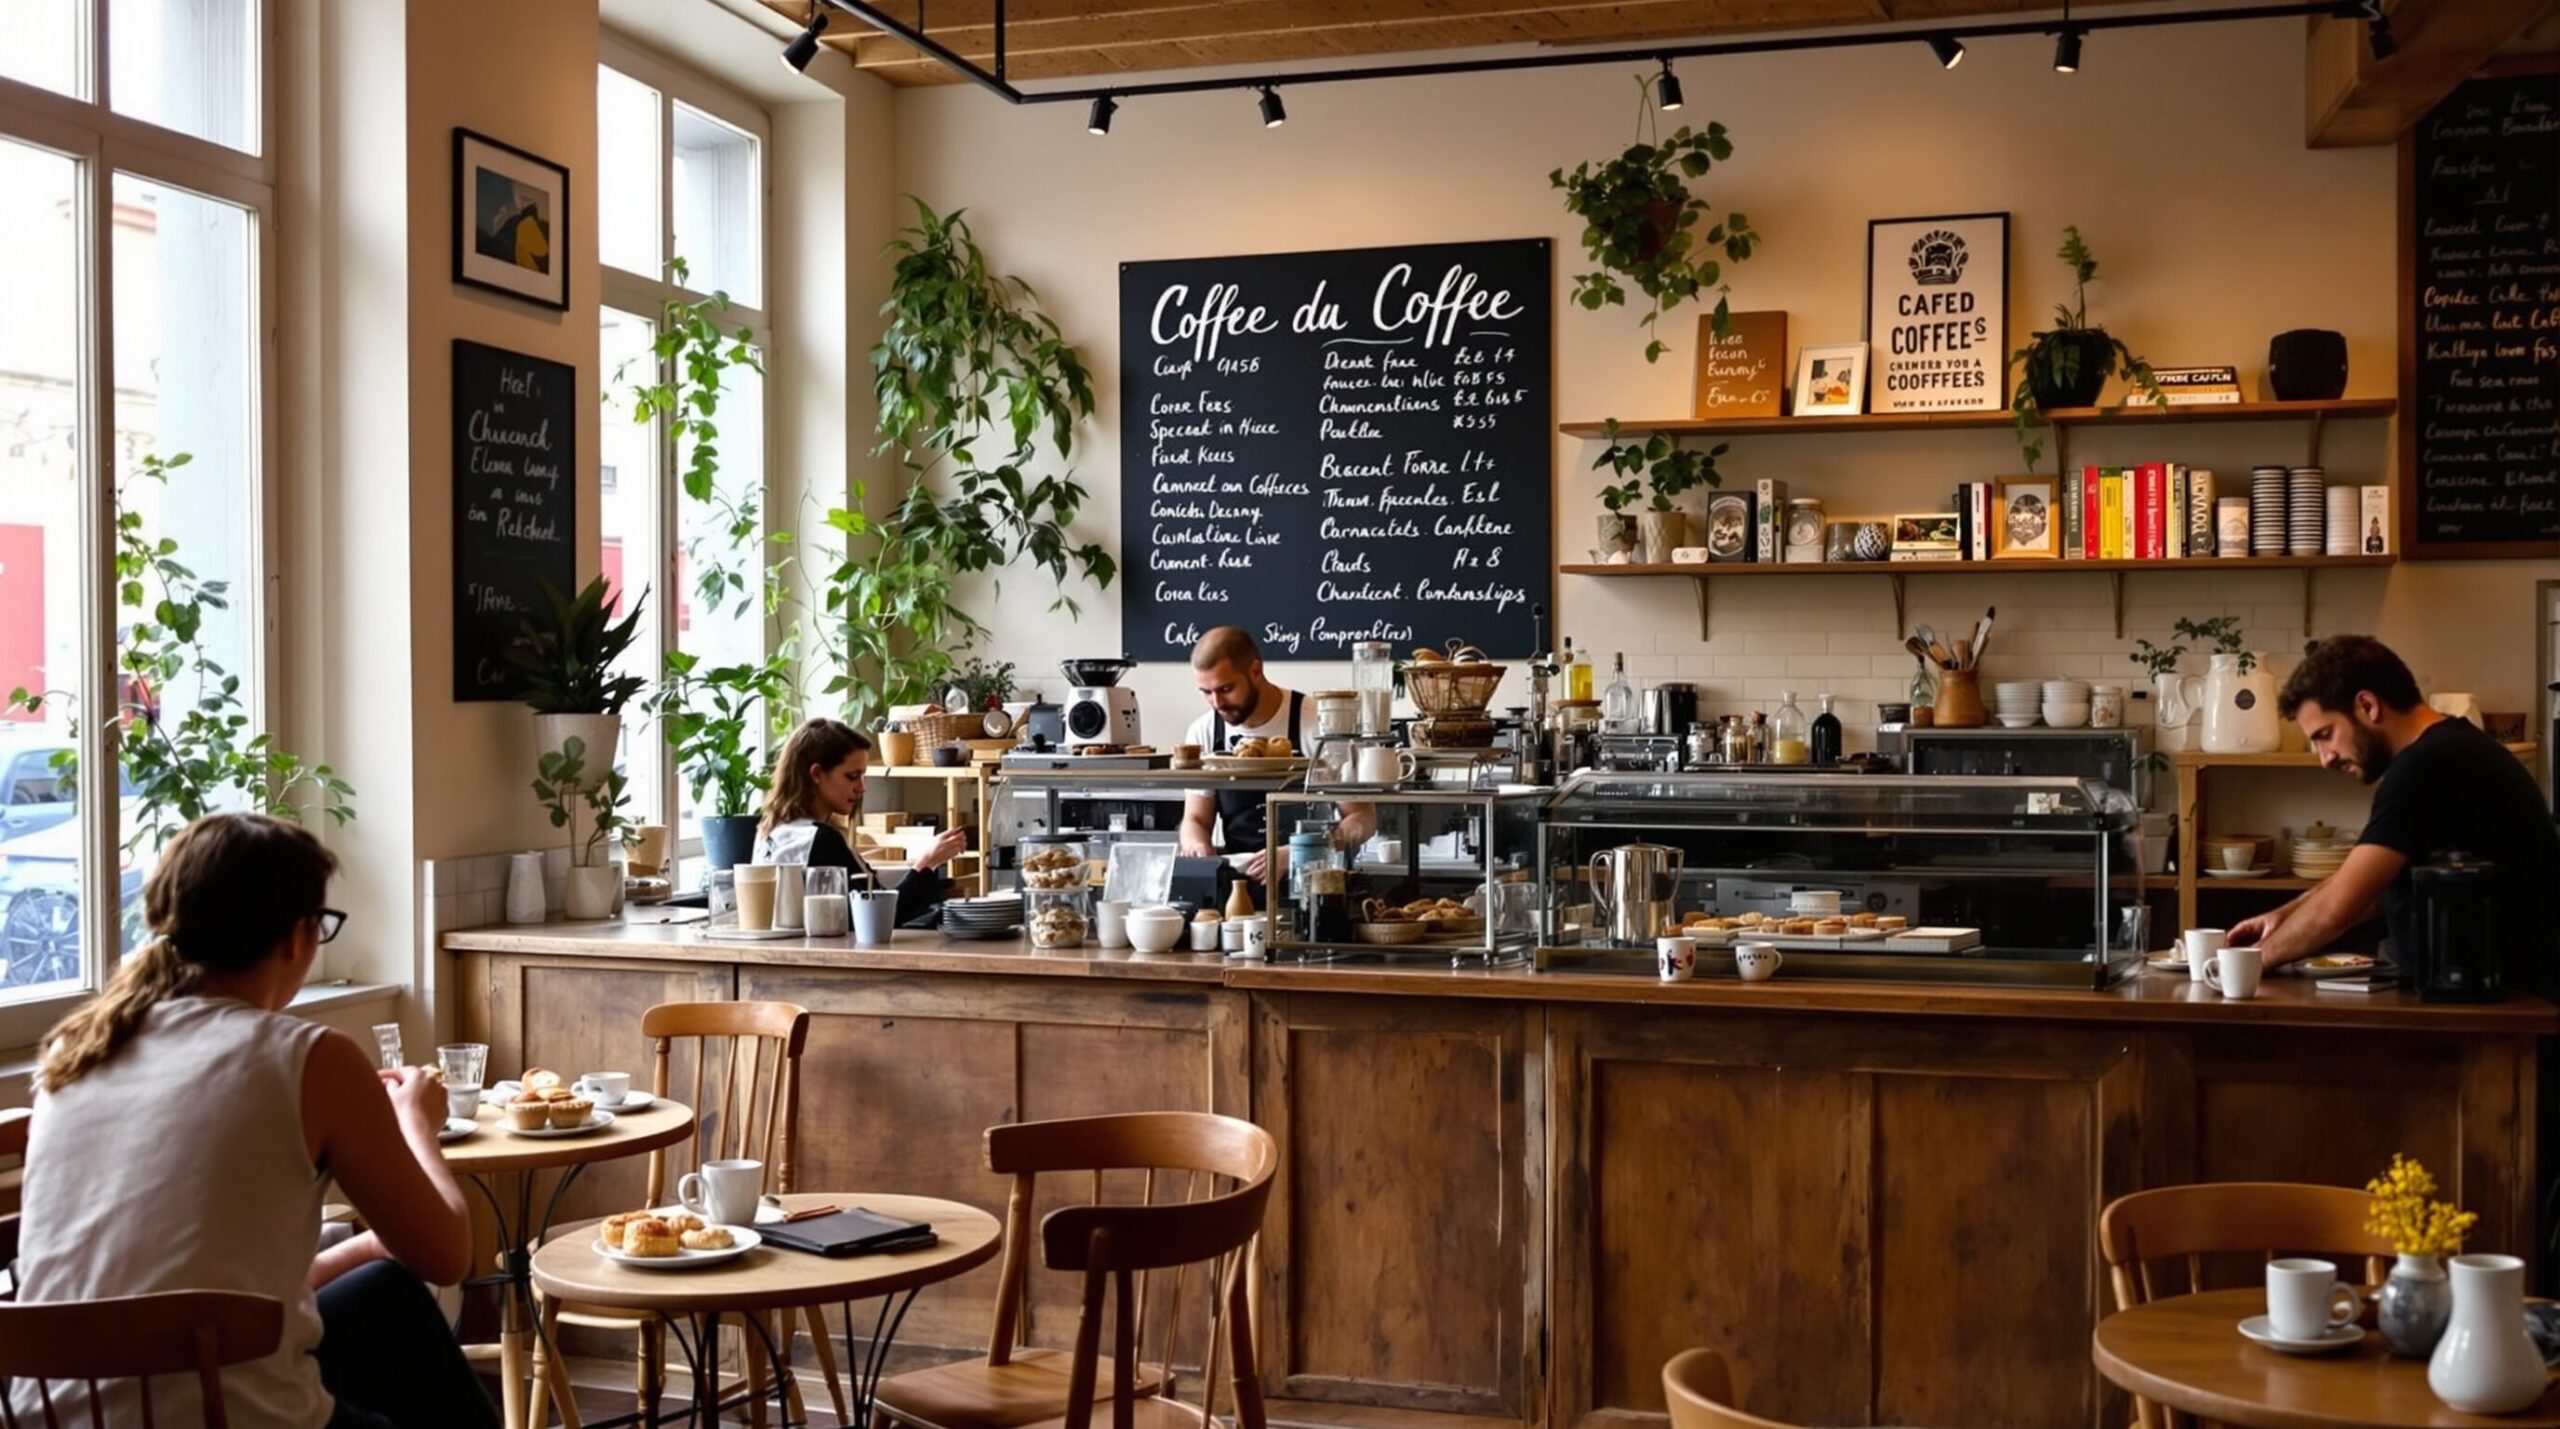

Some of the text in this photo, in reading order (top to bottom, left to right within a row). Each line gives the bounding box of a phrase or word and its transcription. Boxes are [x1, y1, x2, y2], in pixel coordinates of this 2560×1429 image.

[1151, 263, 1524, 361] Coffee du Coffee
[1899, 292, 1974, 316] CAFED
[1219, 420, 1233, 435] in
